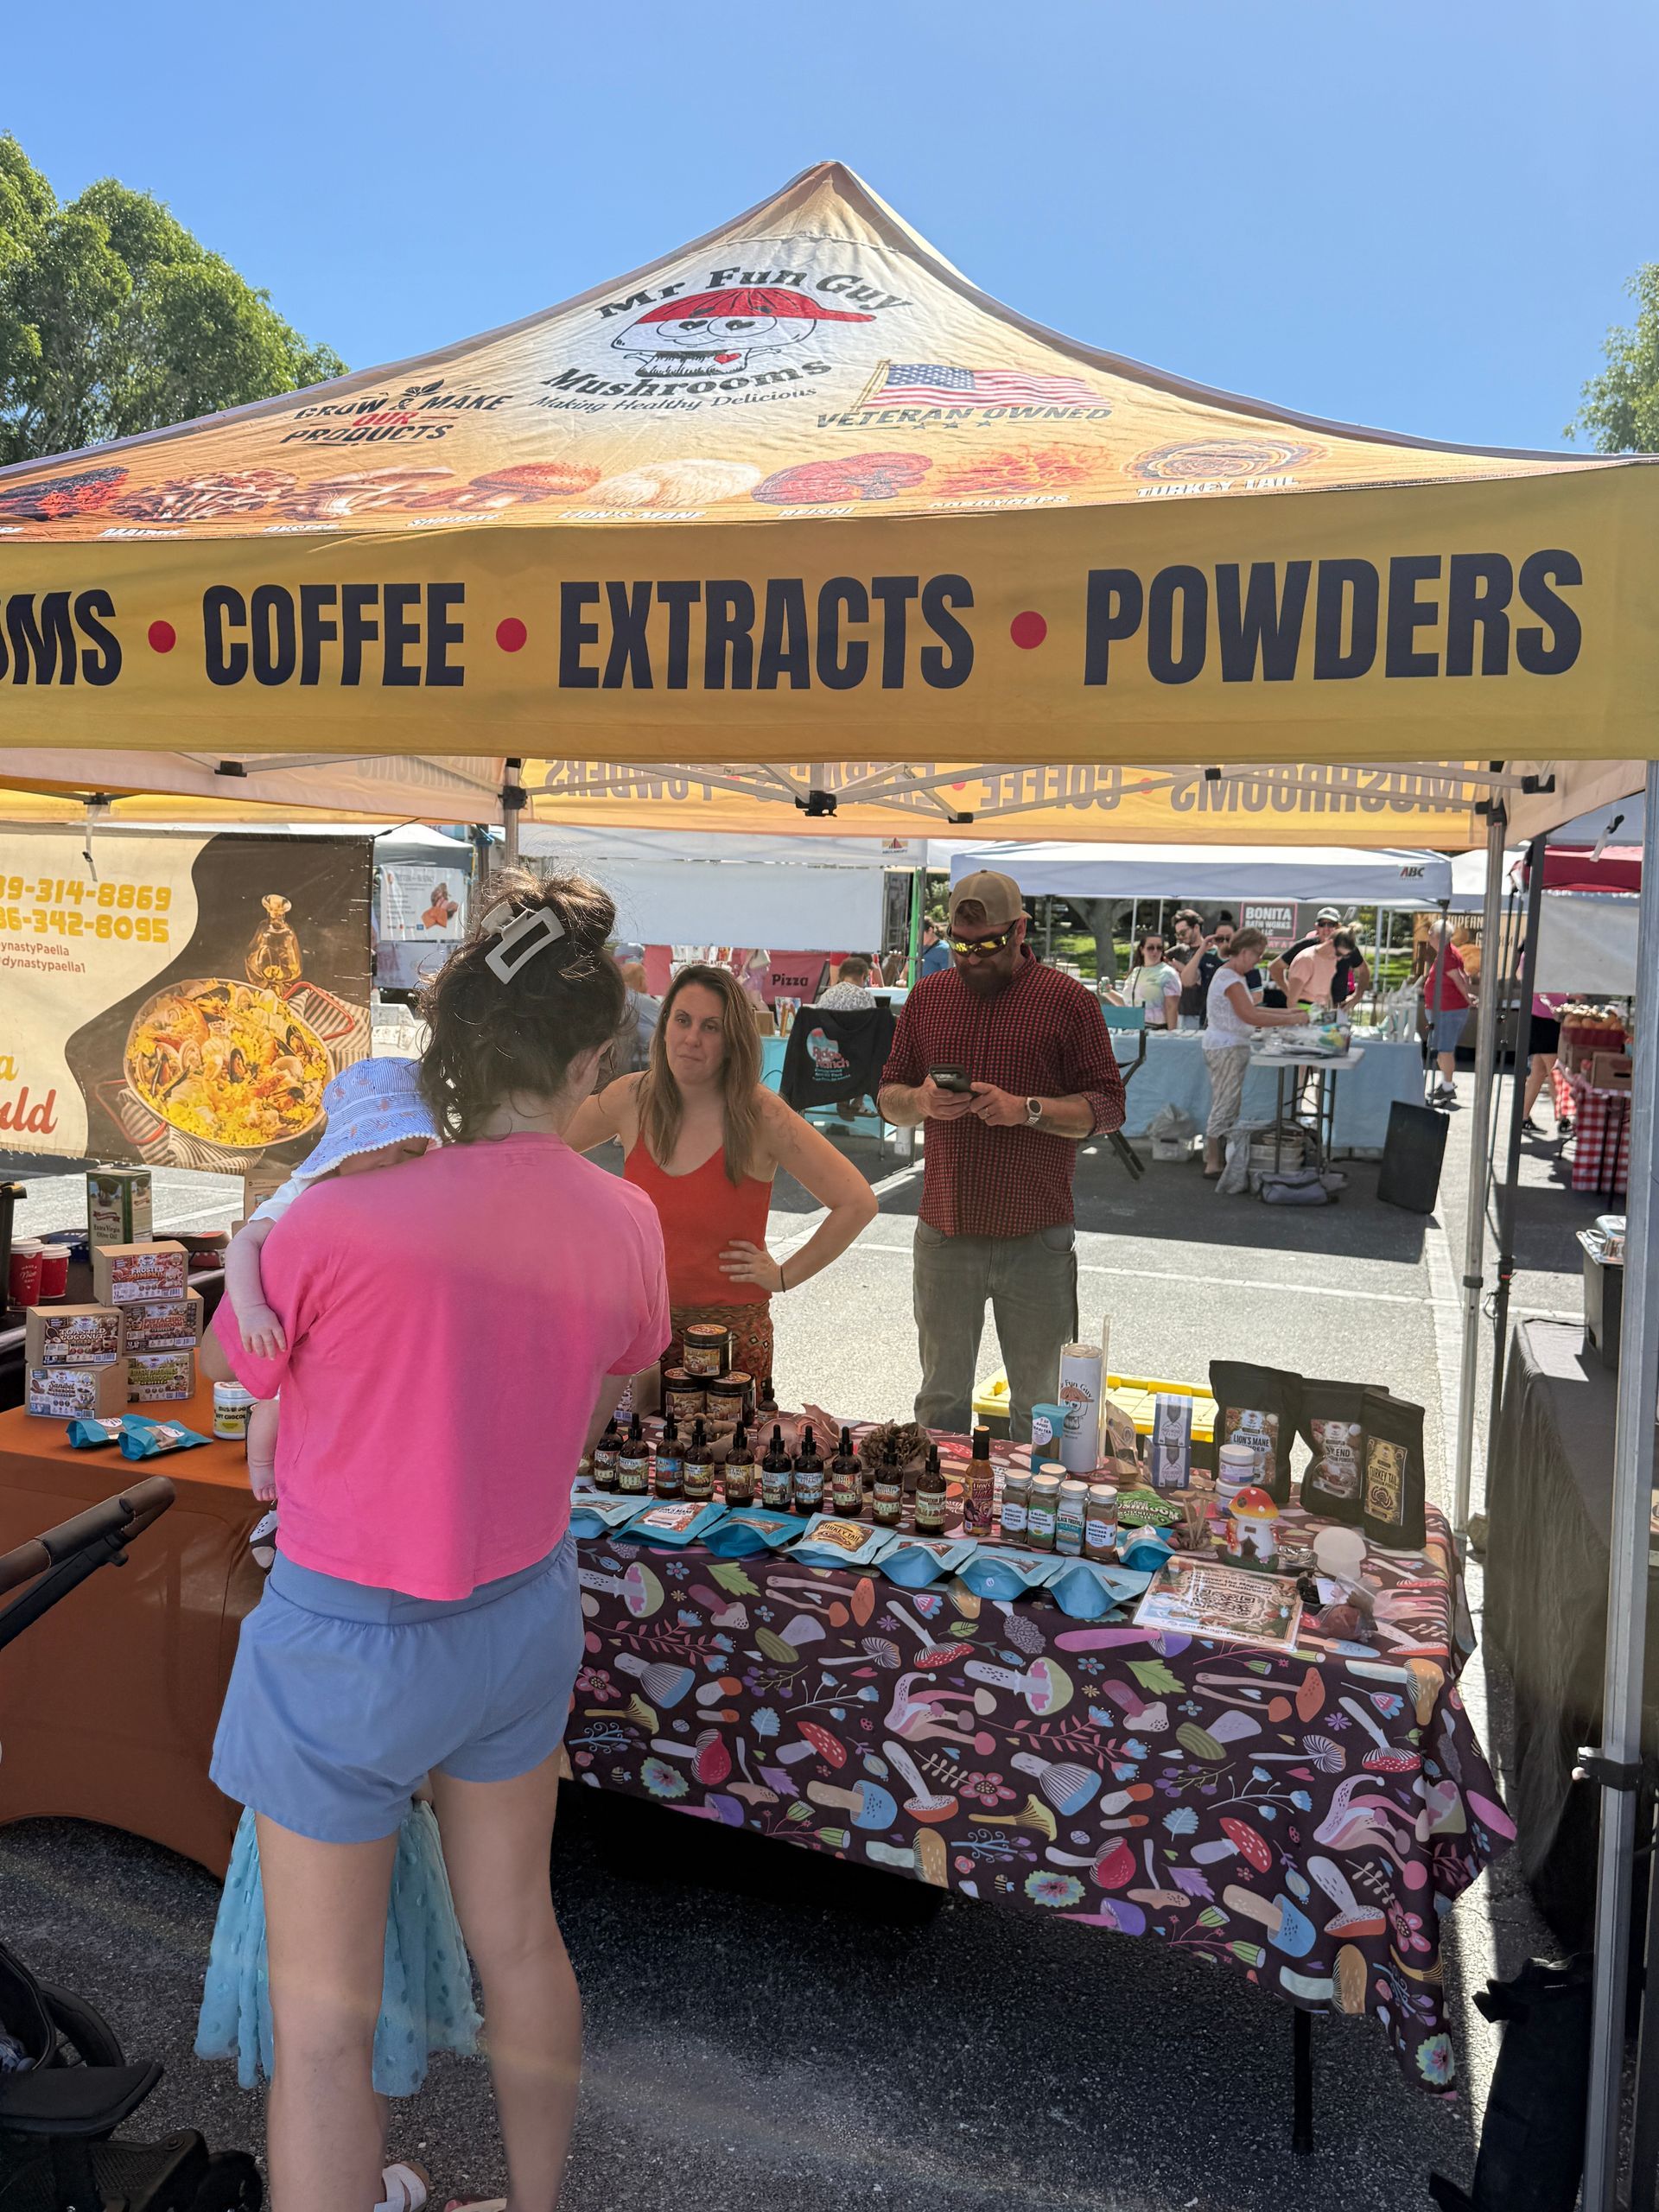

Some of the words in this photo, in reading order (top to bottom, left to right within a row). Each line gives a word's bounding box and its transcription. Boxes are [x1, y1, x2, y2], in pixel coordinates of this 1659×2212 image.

[594, 282, 686, 320] Mr
[706, 266, 807, 289] Fun
[814, 274, 915, 310] Guy
[540, 359, 833, 397] Mushrooms
[294, 397, 390, 420] GROW
[389, 398, 415, 411] &
[417, 395, 515, 410] MAKE
[530, 395, 608, 414] Making
[617, 397, 703, 412] Healthy
[711, 388, 817, 407] Delicious
[353, 411, 419, 426] OUR
[817, 407, 977, 429] VETERAN
[982, 406, 1113, 421] OWNED
[279, 424, 454, 443] PRODUCTS
[1136, 480, 1236, 498] TURKEY
[1243, 476, 1300, 490] TAIL
[202, 582, 465, 689] COFFEE
[558, 574, 974, 690] EXTRACTS
[1084, 549, 1584, 686] POWDERS
[1400, 867, 1425, 877] ABC
[1245, 906, 1293, 920] BONITA
[1265, 920, 1292, 930] WORKS
[0, 941, 70, 957] ynastyPaella
[772, 974, 809, 986] Pizza
[1233, 1434, 1251, 1445] LION'S
[1252, 1437, 1269, 1447] MANE
[1370, 1465, 1388, 1482] TURKEY
[1388, 1472, 1397, 1485] TAIL
[822, 1522, 848, 1535] TURKEY
[847, 1532, 861, 1542] TAIL
